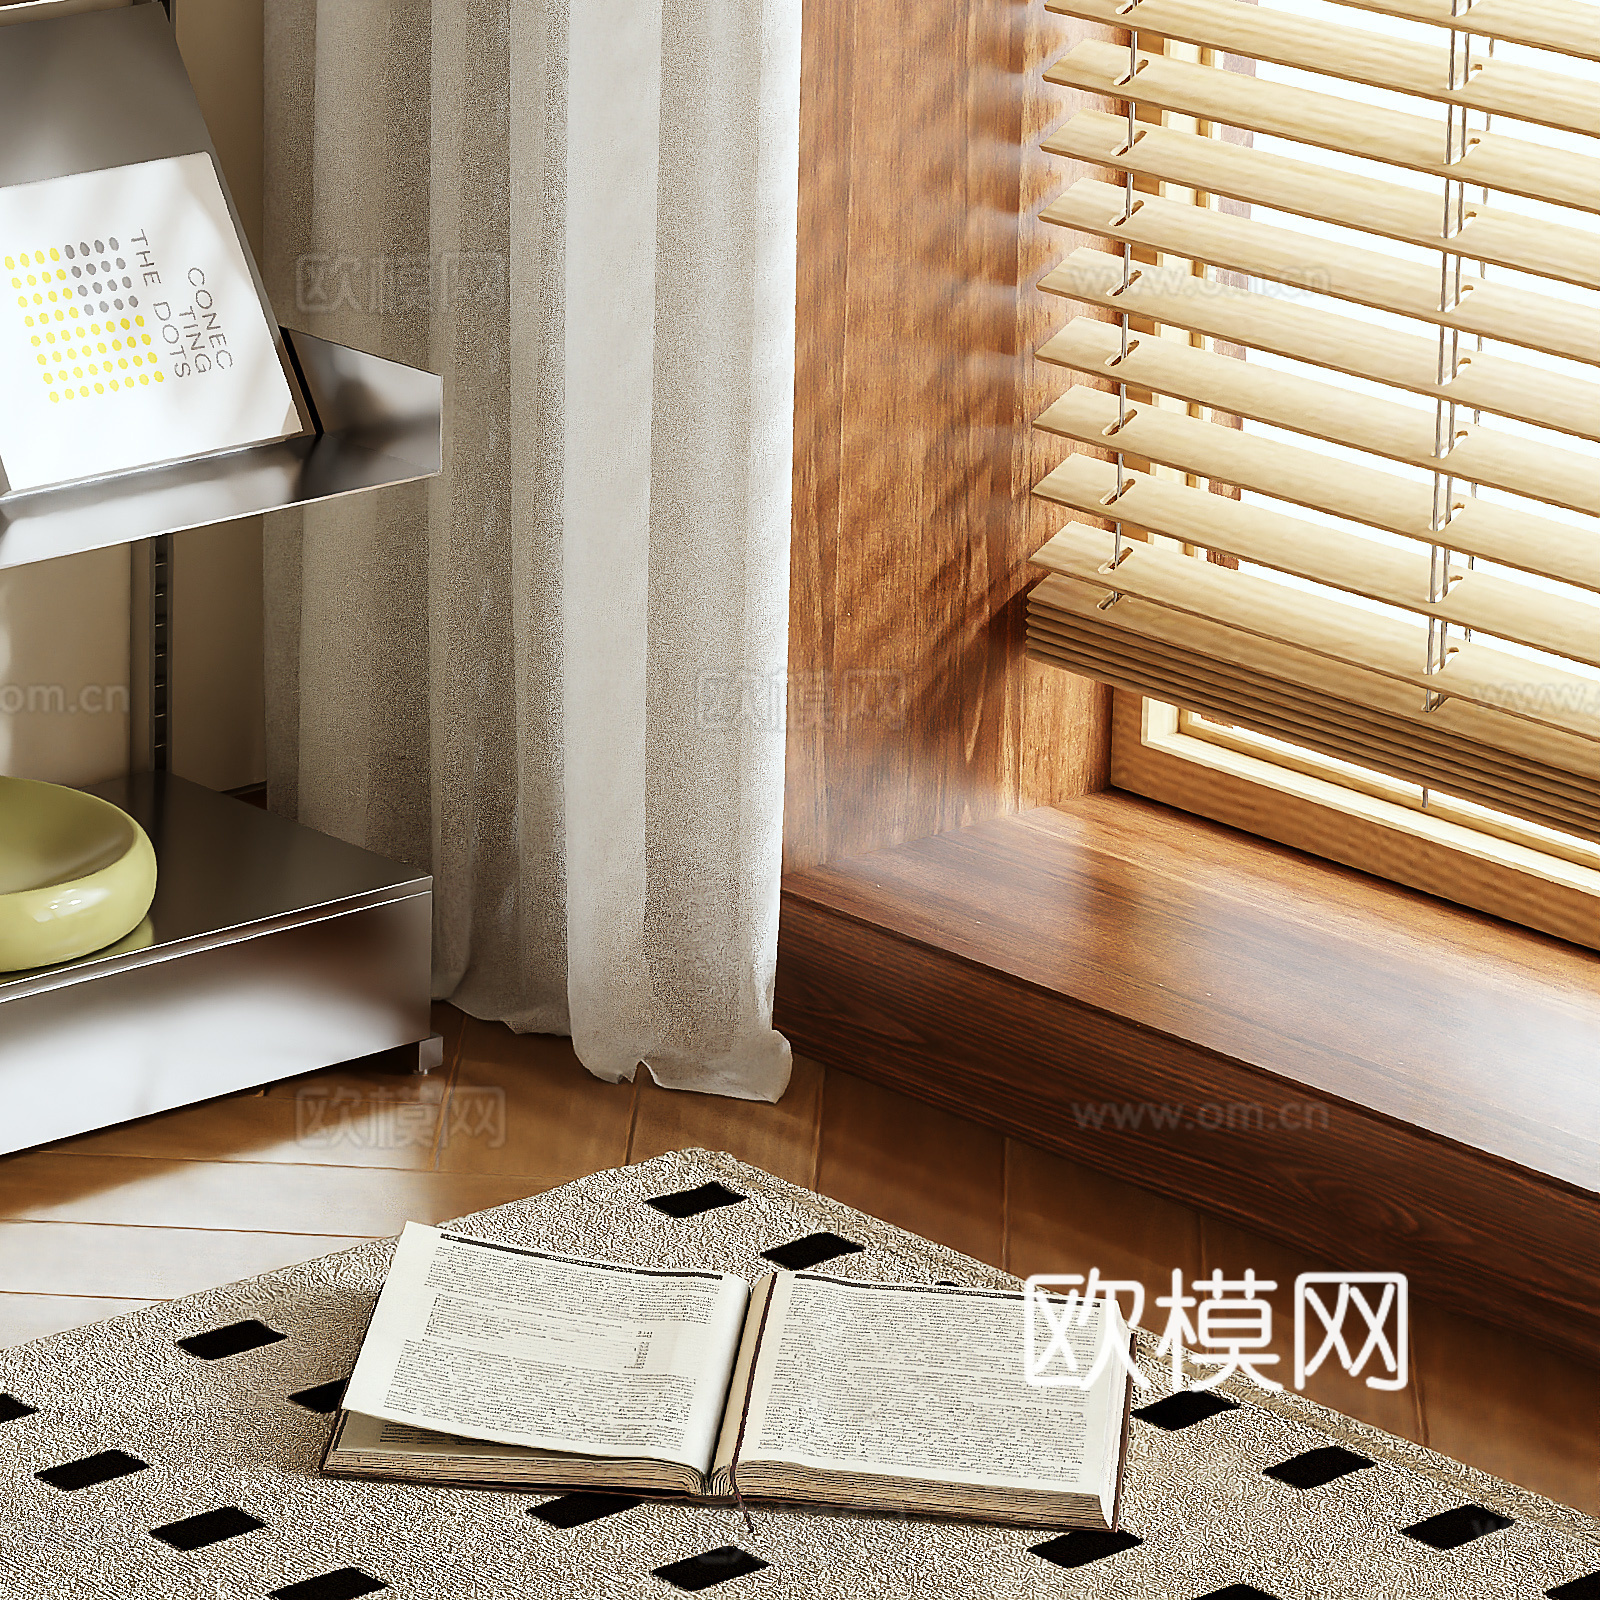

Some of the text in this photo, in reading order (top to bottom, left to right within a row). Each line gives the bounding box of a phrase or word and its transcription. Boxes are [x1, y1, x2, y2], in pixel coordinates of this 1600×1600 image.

[131, 229, 191, 378] THE DOTS
[179, 306, 212, 373] TING
[188, 268, 233, 370] CONEC
